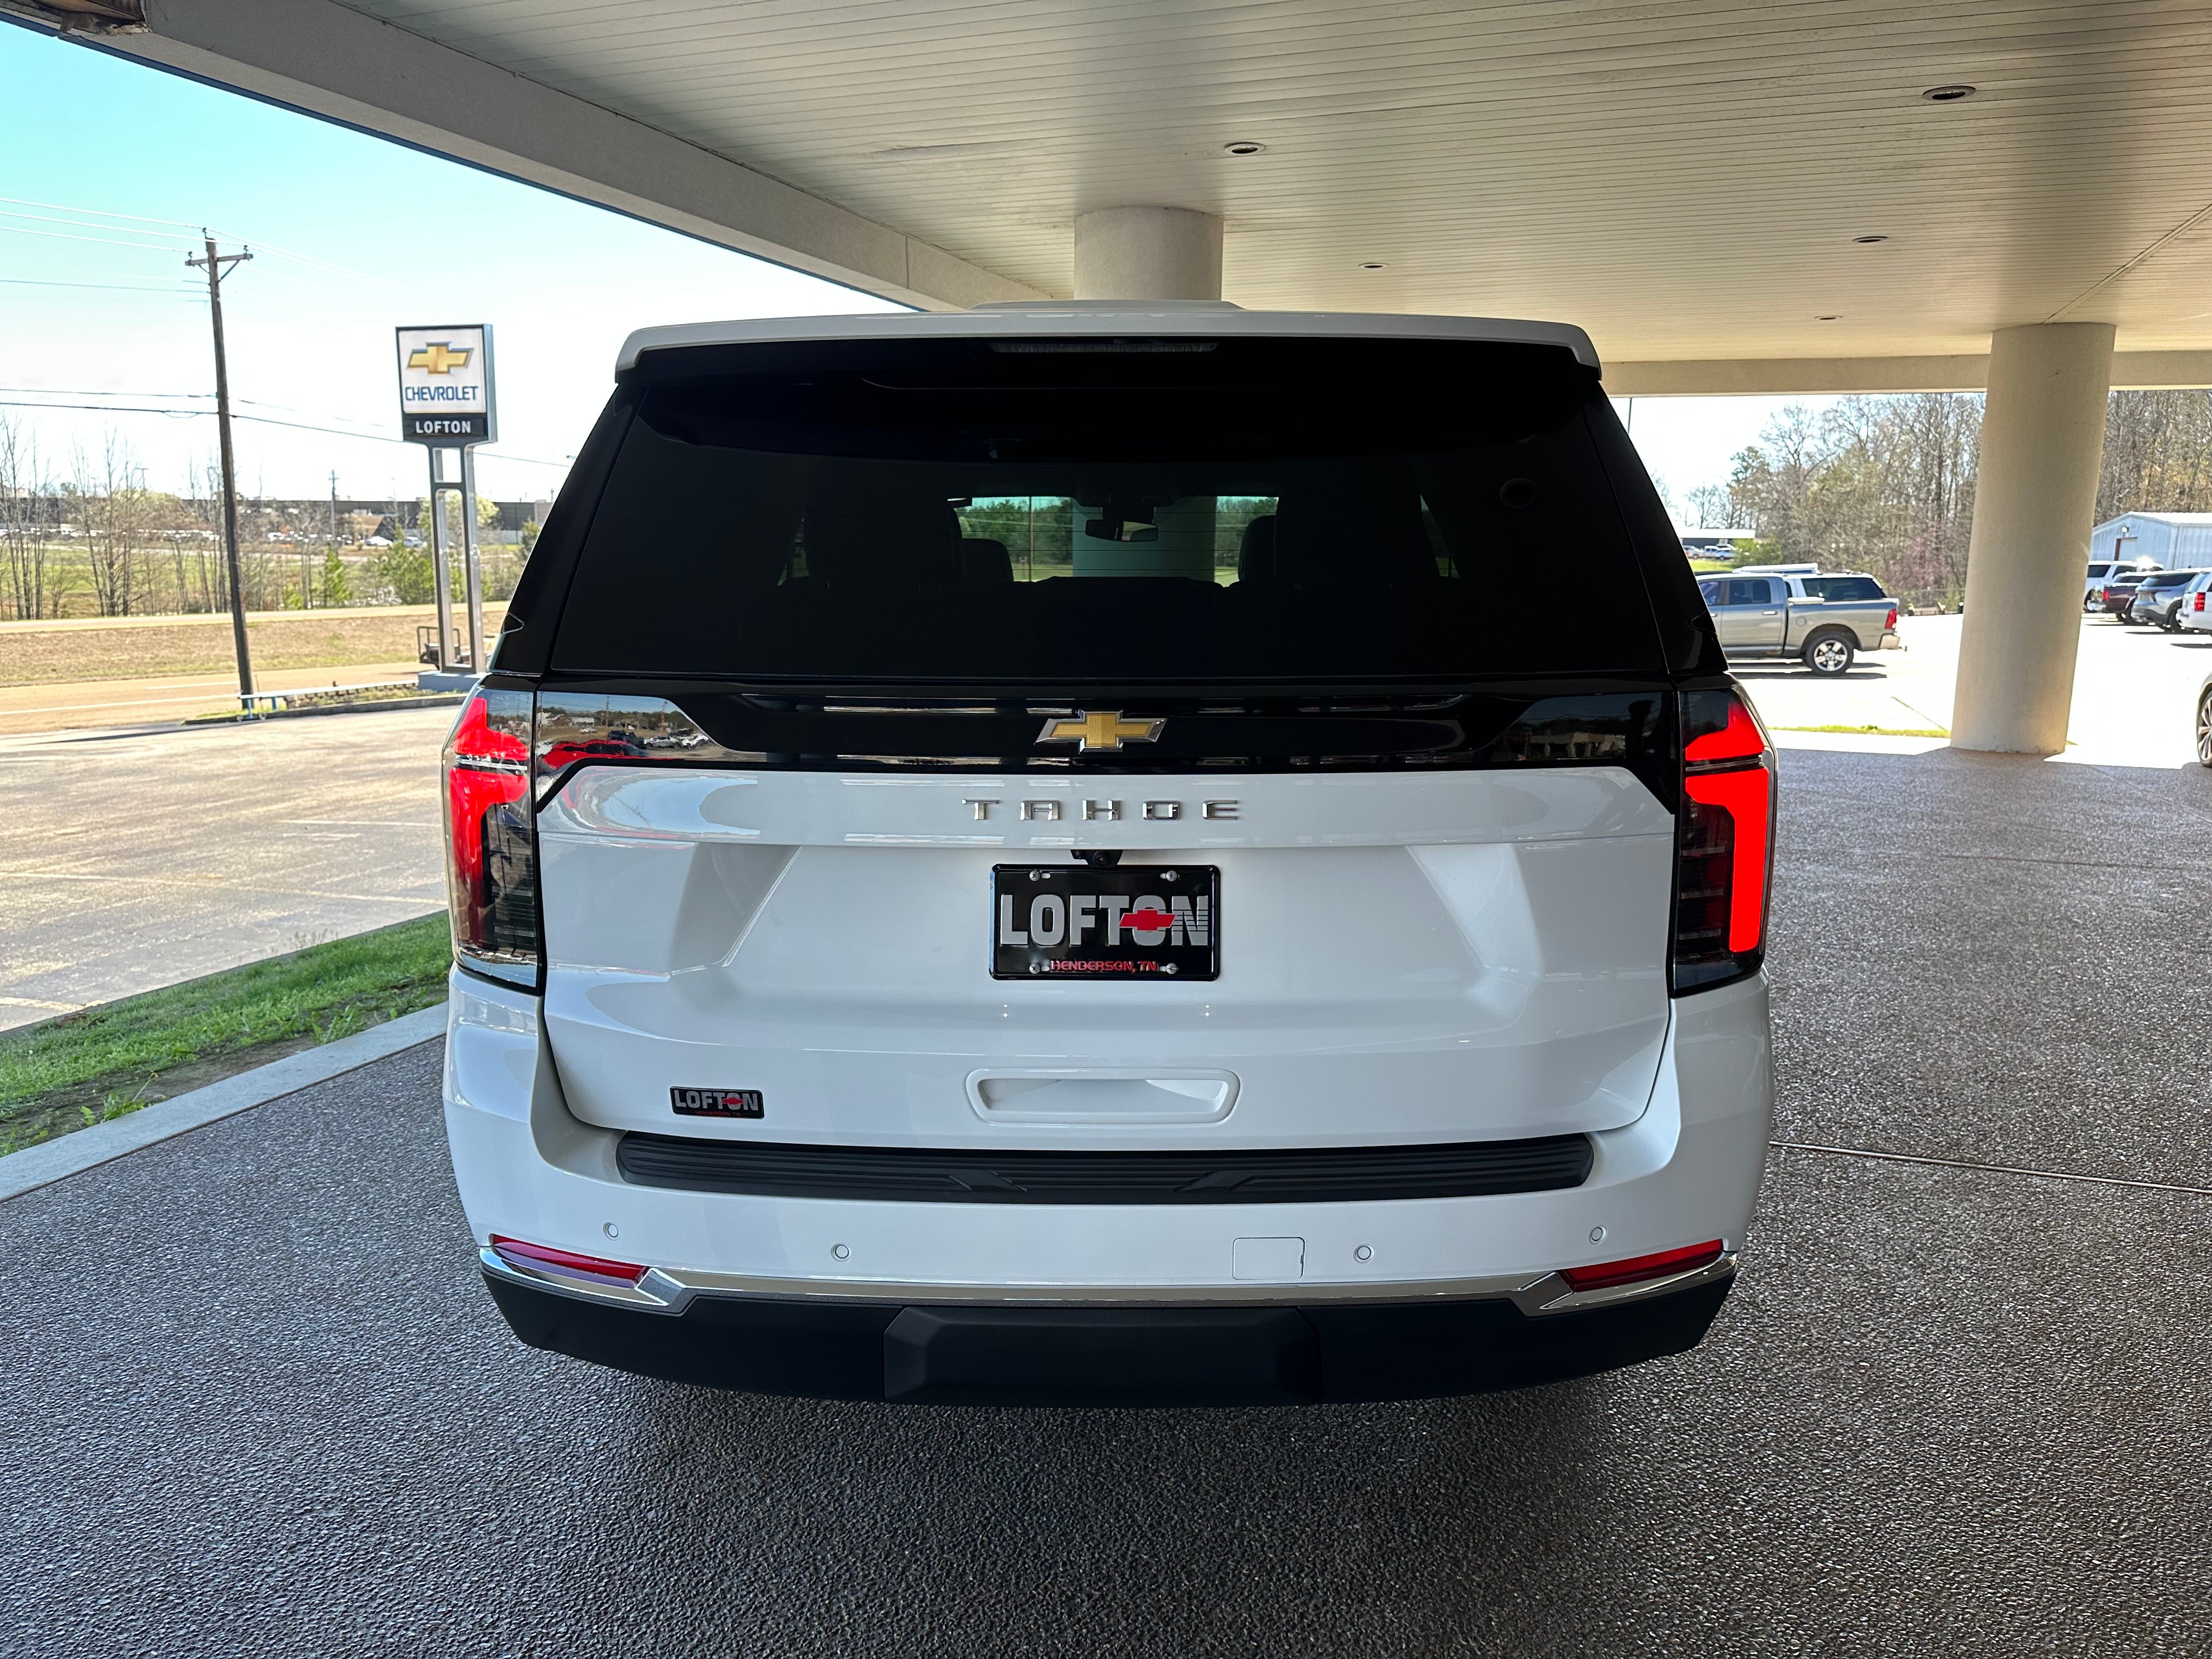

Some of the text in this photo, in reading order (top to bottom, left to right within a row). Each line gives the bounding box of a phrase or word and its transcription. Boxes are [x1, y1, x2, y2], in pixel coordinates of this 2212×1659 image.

[405, 386, 478, 400] CHEVROLET
[415, 420, 471, 433] LOFTON
[962, 799, 1239, 820] TAHOE
[1000, 894, 1209, 946] LOFTON
[1050, 961, 1157, 974] HENDERSON, TN
[674, 1090, 759, 1111] LOFTON
